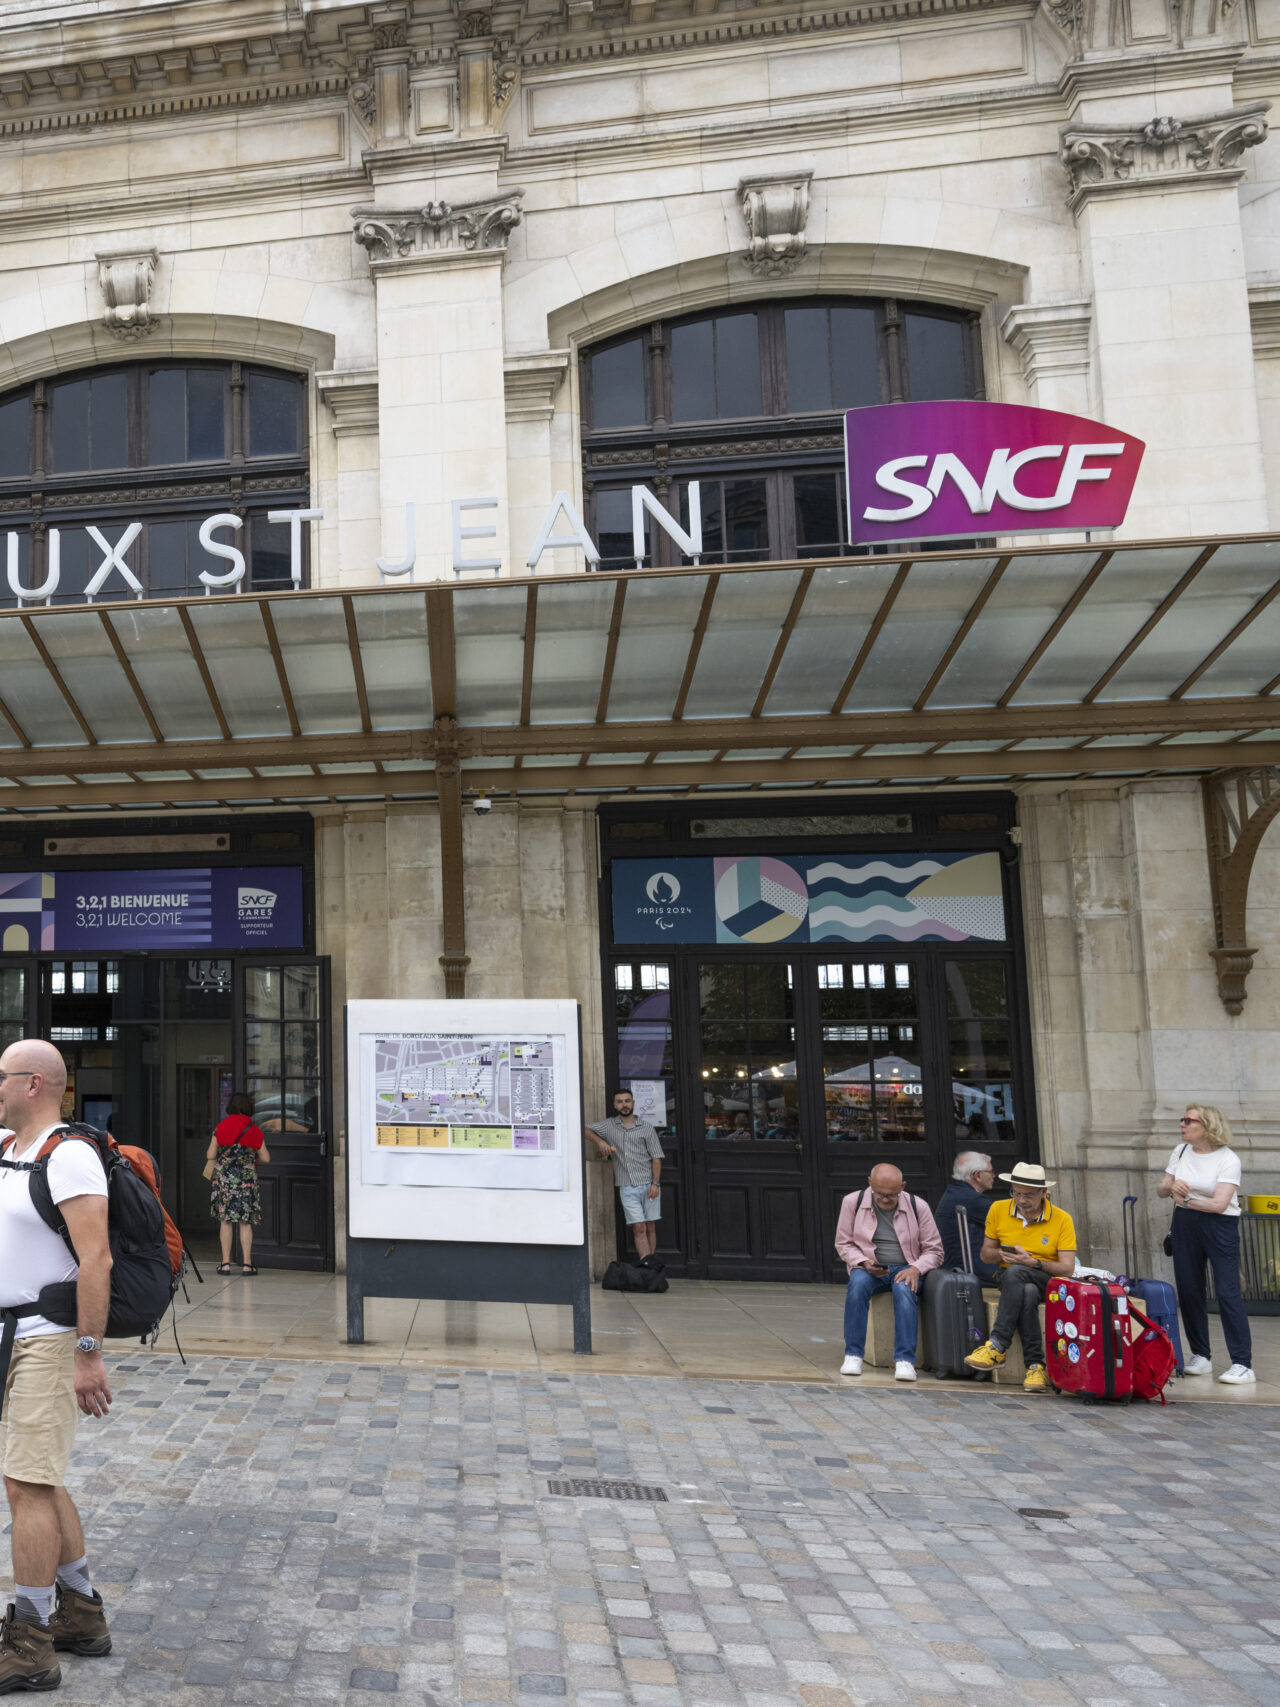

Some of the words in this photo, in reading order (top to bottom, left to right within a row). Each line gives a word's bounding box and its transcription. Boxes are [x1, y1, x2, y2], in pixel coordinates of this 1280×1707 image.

[862, 443, 1125, 523] SNCF
[198, 508, 324, 589] ST
[375, 480, 704, 576] JEAN
[76, 895, 107, 910] 3,2,1
[110, 893, 189, 908] BIENVENUE
[240, 895, 274, 905] SNCF
[75, 913, 103, 928] 3,2,1
[107, 912, 182, 926] WELCOME
